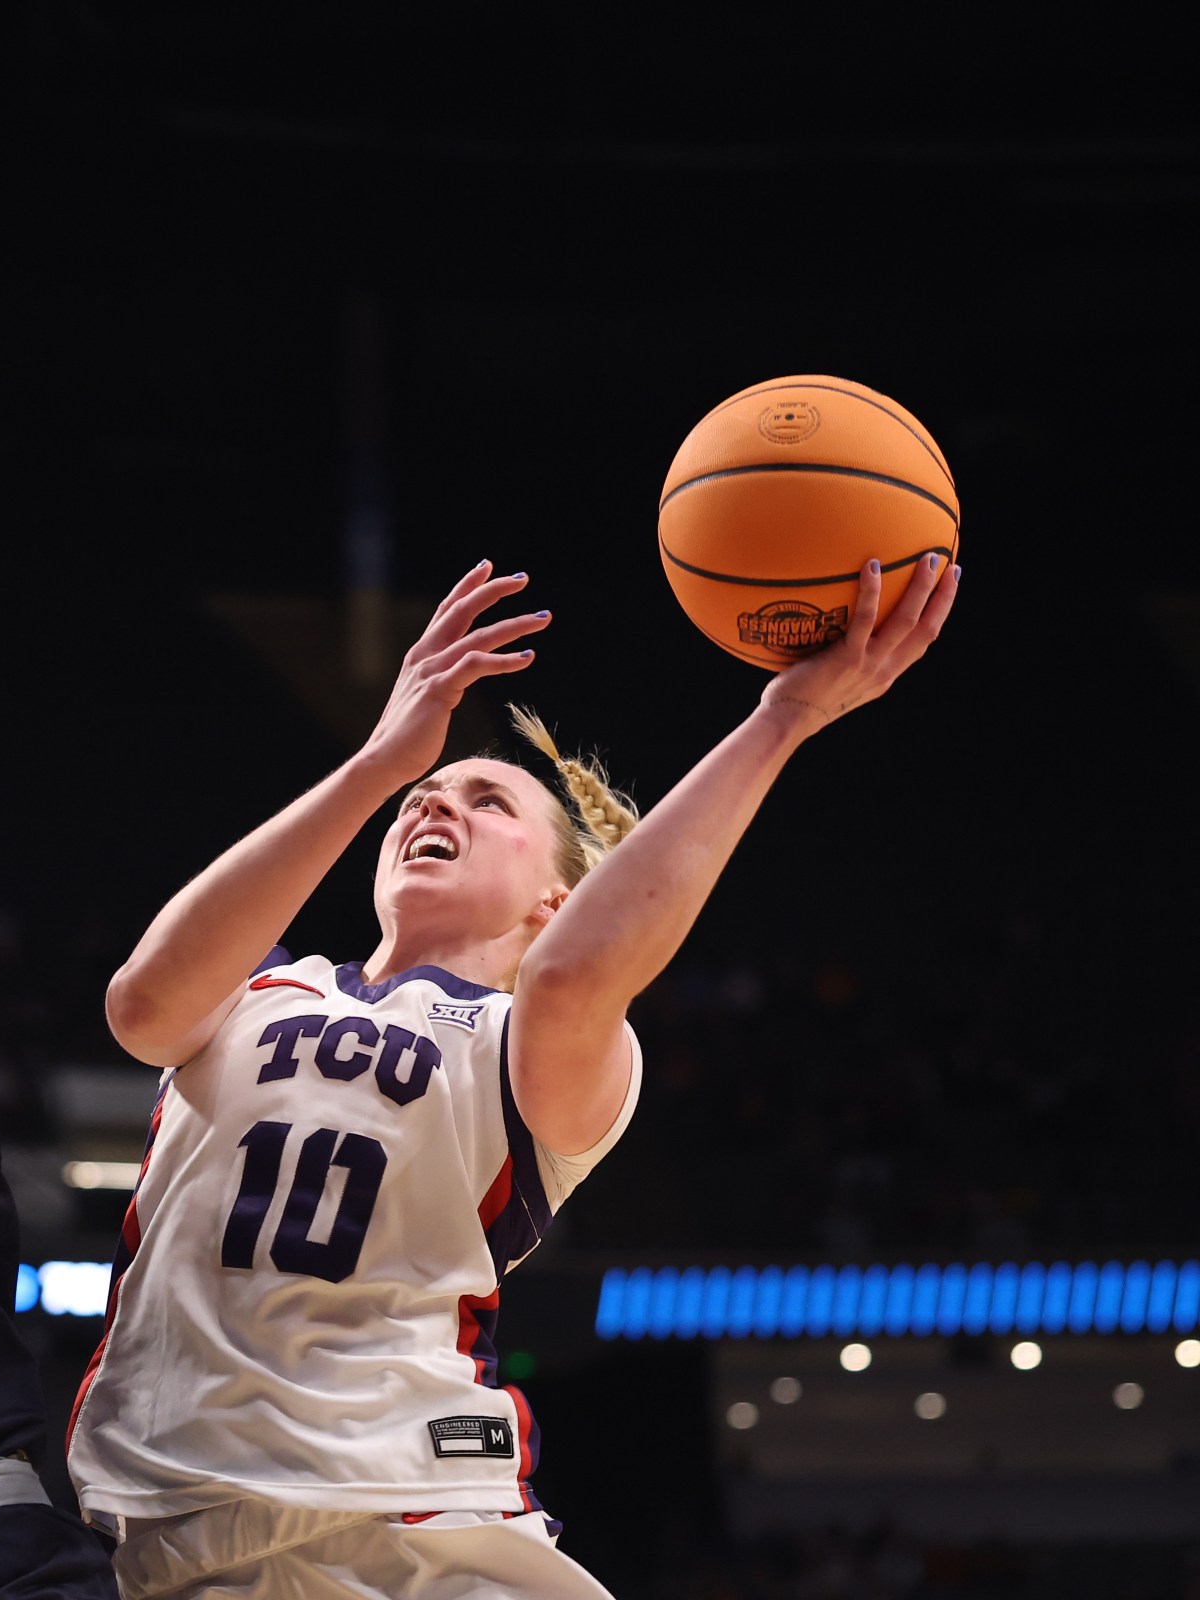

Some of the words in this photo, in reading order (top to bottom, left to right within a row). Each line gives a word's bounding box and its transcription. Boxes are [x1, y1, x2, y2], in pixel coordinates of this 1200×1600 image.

[738, 615, 816, 634] MADNESS
[767, 626, 827, 646] MARCH
[256, 1014, 442, 1107] TCU
[221, 1120, 388, 1284] 10
[490, 1428, 505, 1445] M
